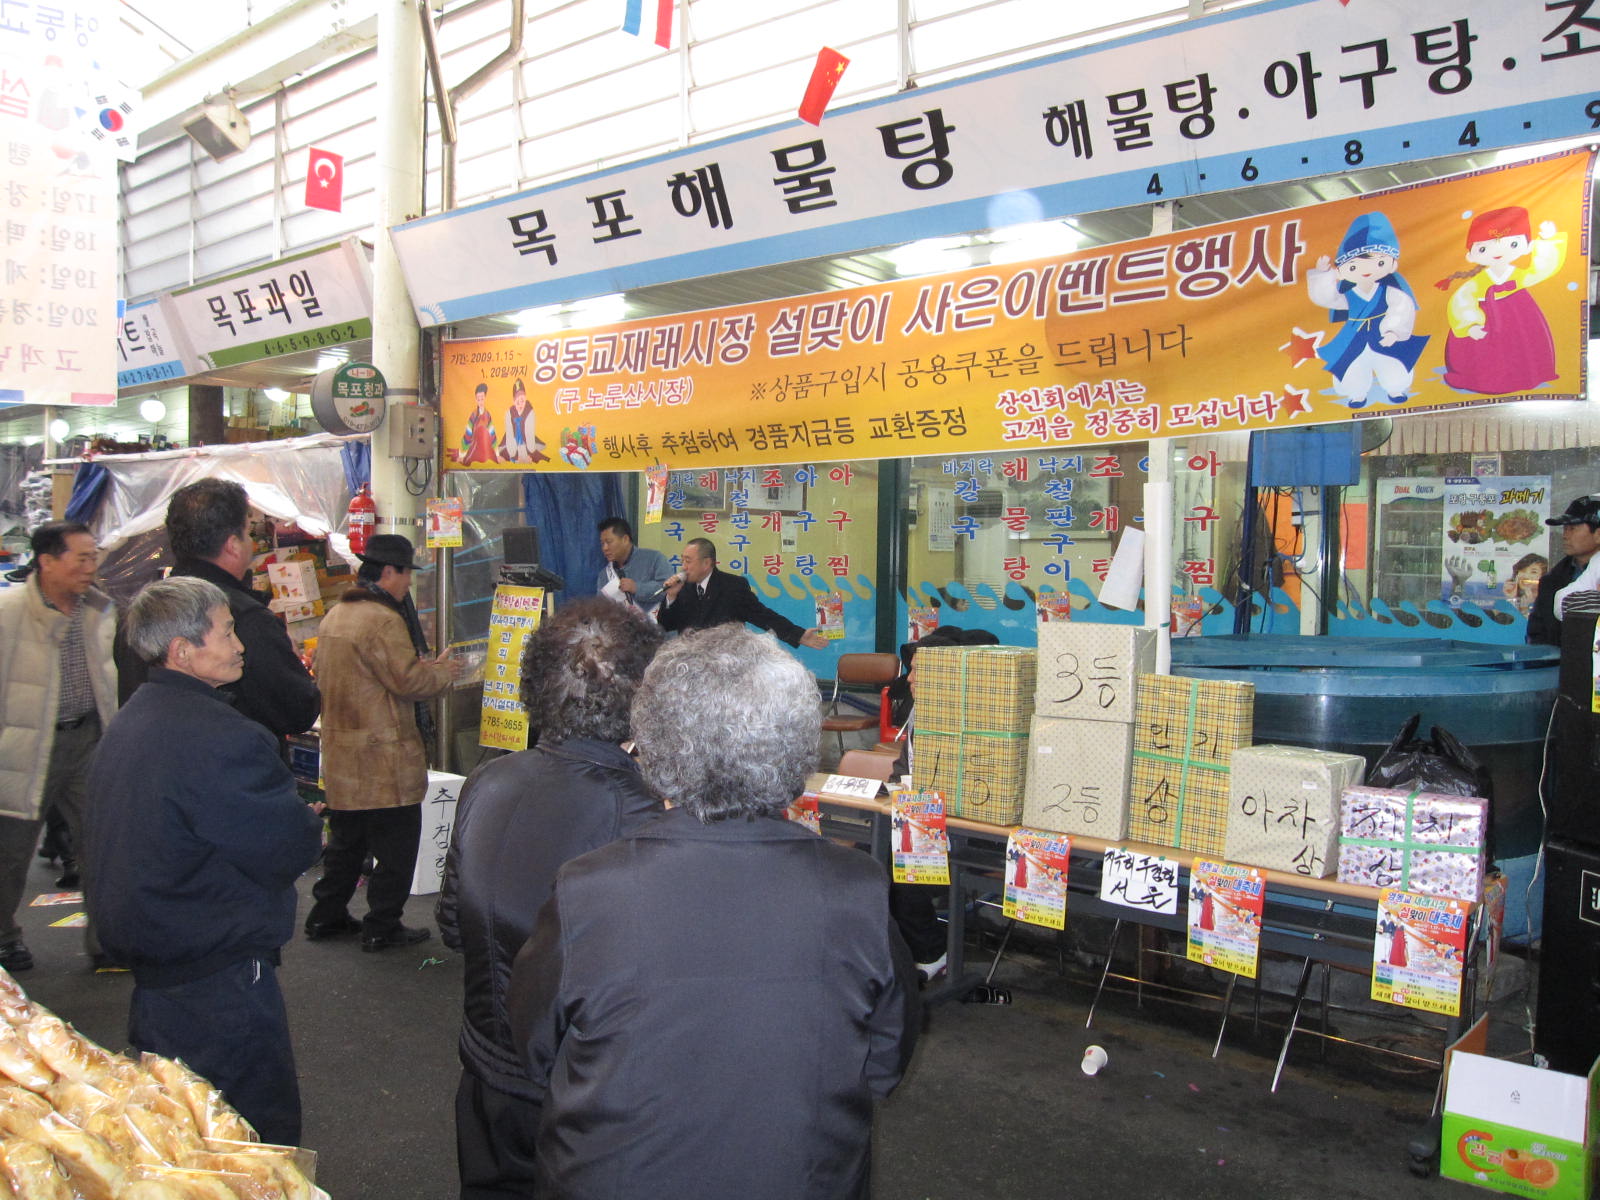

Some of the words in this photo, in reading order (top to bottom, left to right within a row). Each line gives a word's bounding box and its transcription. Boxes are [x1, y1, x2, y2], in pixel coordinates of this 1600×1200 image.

[207, 270, 323, 337] 목포과일
[535, 317, 756, 382] 영동교재래시장
[768, 293, 892, 357] 설맞이
[897, 342, 1044, 389] 공용쿠폰을
[1053, 323, 1193, 367] 드립니다
[337, 381, 384, 398] 목포청과
[554, 377, 694, 414] (구.노룬산시장)
[997, 380, 1146, 417] 상인회에서는
[602, 432, 652, 458] 행사후
[661, 427, 740, 456] 추첨하여
[745, 416, 855, 451] 경품지급등
[868, 406, 968, 441] 교환증정
[1003, 414, 1074, 442] 고객을
[1086, 405, 1160, 438] 정중히
[1169, 392, 1281, 429] 모십니다
[669, 471, 695, 487] 지락
[942, 456, 993, 475] 바지락
[1038, 454, 1083, 473] 낙지
[1415, 485, 1436, 495] QUICK
[1499, 486, 1545, 505] 과메기
[1052, 652, 1121, 709] 3등
[1150, 721, 1220, 760] 인기
[927, 749, 997, 807] 1등
[1042, 782, 1101, 824] 2등
[1144, 777, 1179, 824] 상
[1241, 788, 1316, 840] 아차
[1292, 844, 1326, 876] 상
[1368, 855, 1405, 888] 상
